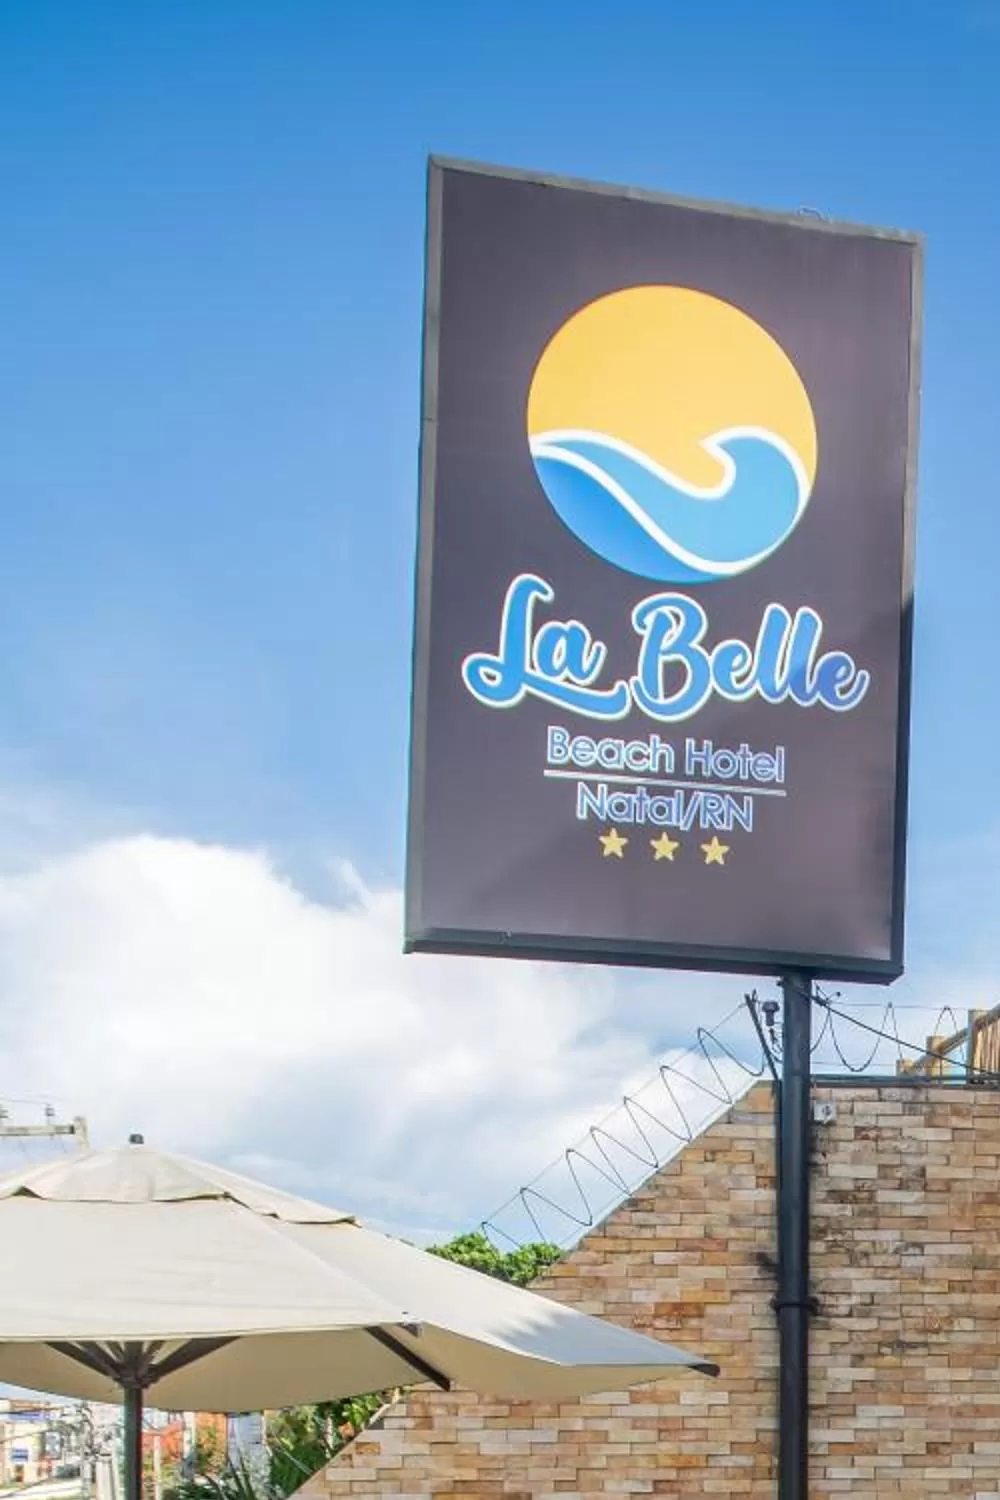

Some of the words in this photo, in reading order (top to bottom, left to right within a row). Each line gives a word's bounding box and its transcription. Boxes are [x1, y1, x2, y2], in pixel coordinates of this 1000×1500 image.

[462, 573, 632, 719] La
[632, 592, 870, 722] Belle
[546, 726, 673, 774] Beach
[685, 738, 785, 783] Hotel
[576, 782, 753, 832] Natal/RN
